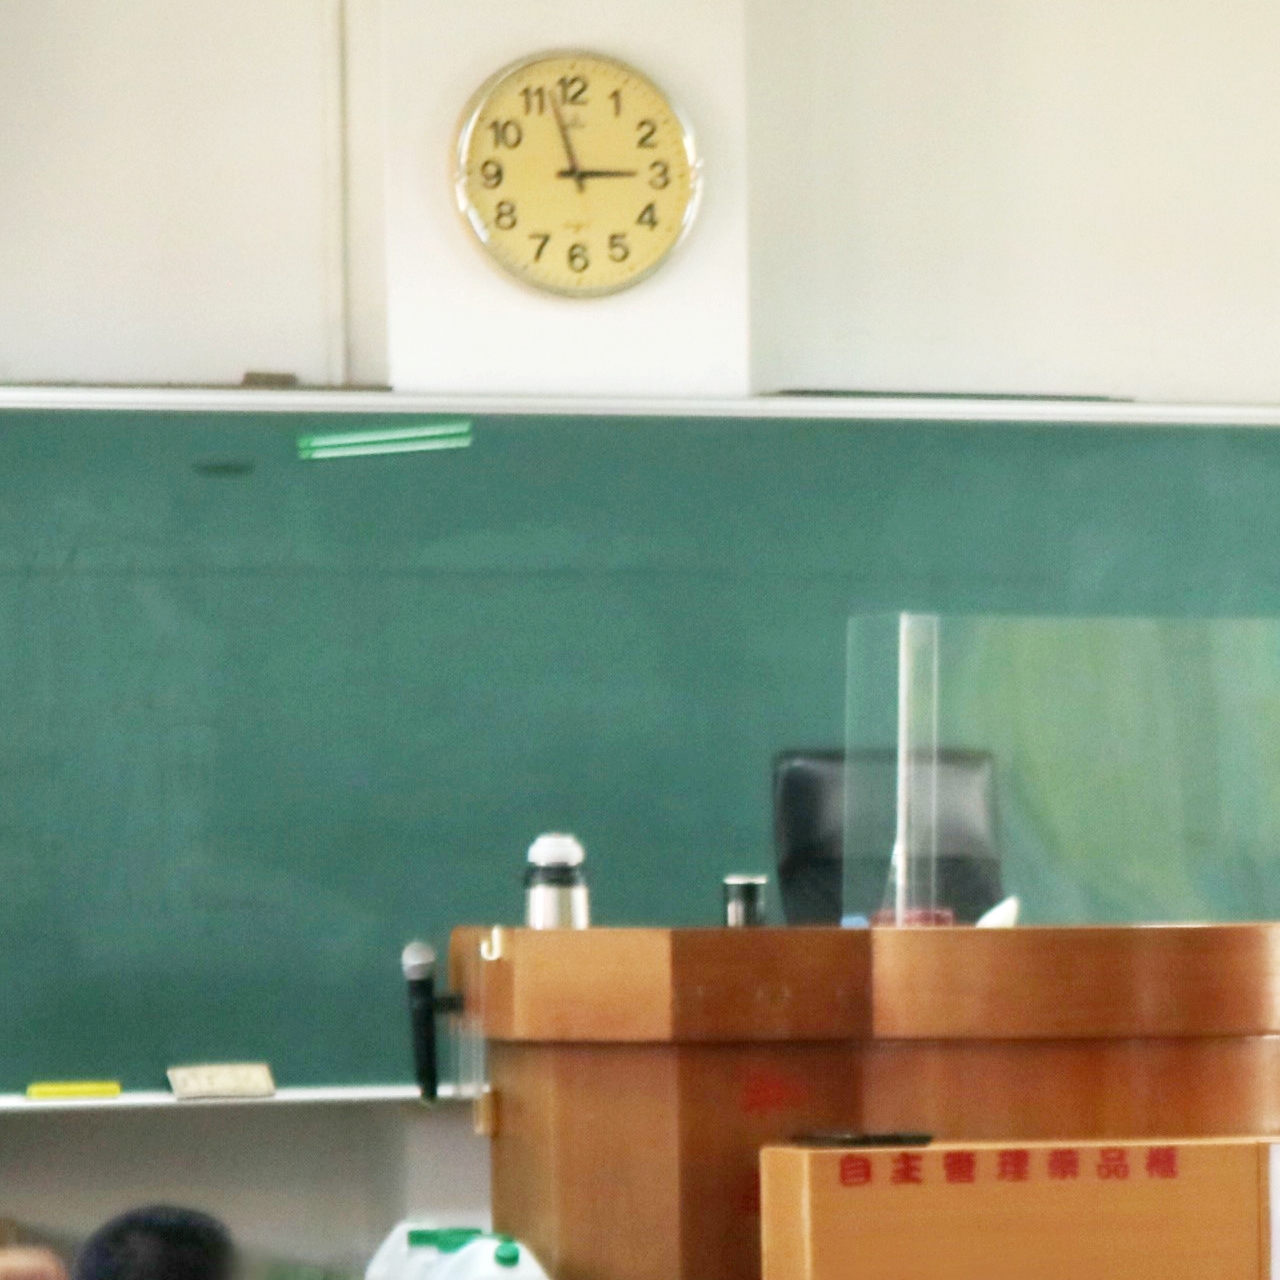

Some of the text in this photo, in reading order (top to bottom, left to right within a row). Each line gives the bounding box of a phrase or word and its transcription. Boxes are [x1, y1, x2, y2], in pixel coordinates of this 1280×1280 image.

[520, 86, 546, 115] 11
[558, 75, 589, 105] 12
[608, 89, 623, 117] 1
[489, 120, 522, 150] 10
[636, 120, 657, 149] 2
[480, 159, 504, 190] 9
[649, 160, 670, 191] 3
[494, 200, 517, 231] 8
[636, 202, 659, 231] 4
[529, 233, 550, 263] 7
[568, 243, 590, 273] 6
[608, 232, 629, 263] 5
